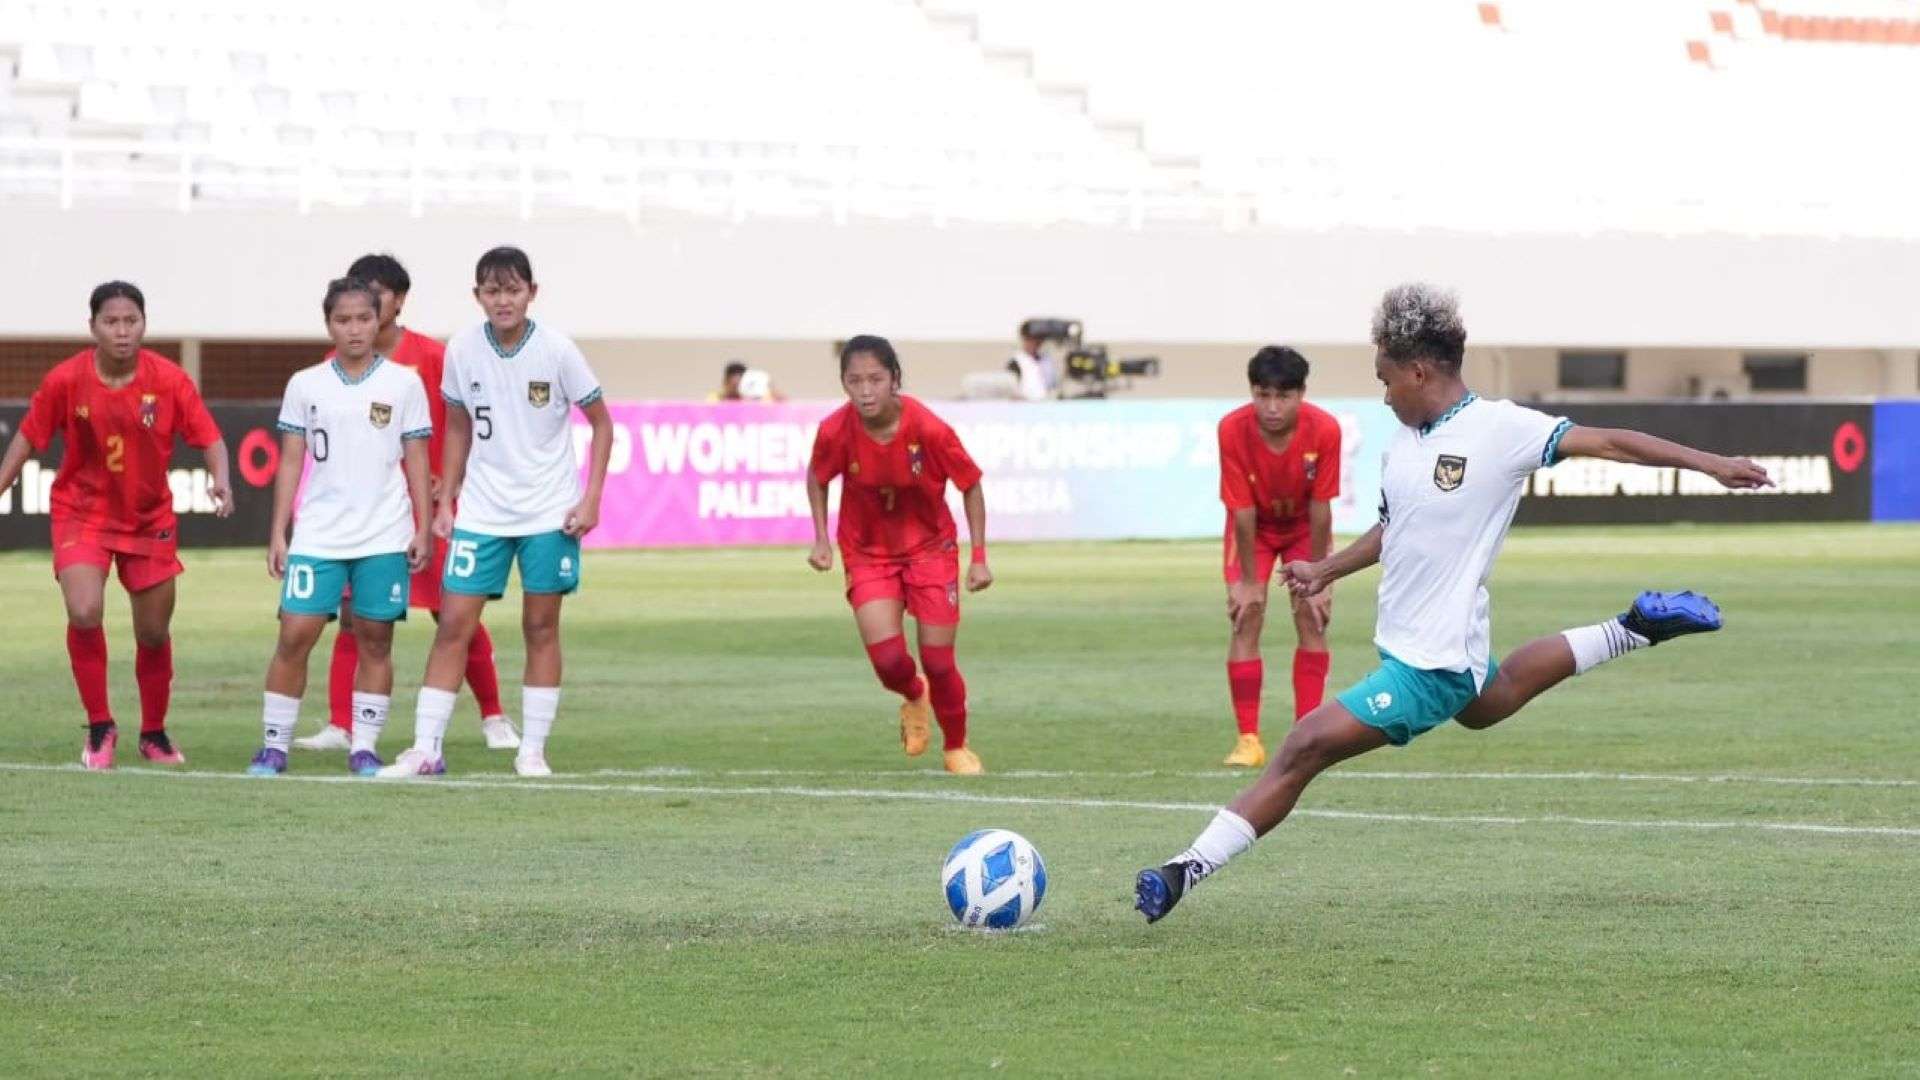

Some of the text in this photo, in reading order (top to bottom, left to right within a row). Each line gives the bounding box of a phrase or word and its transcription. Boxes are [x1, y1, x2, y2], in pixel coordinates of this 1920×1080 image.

[106, 434, 126, 473] 2
[641, 422, 819, 475] WOMEN
[698, 481, 814, 519] PALEM
[447, 539, 479, 578] 15
[286, 564, 315, 599] 10
